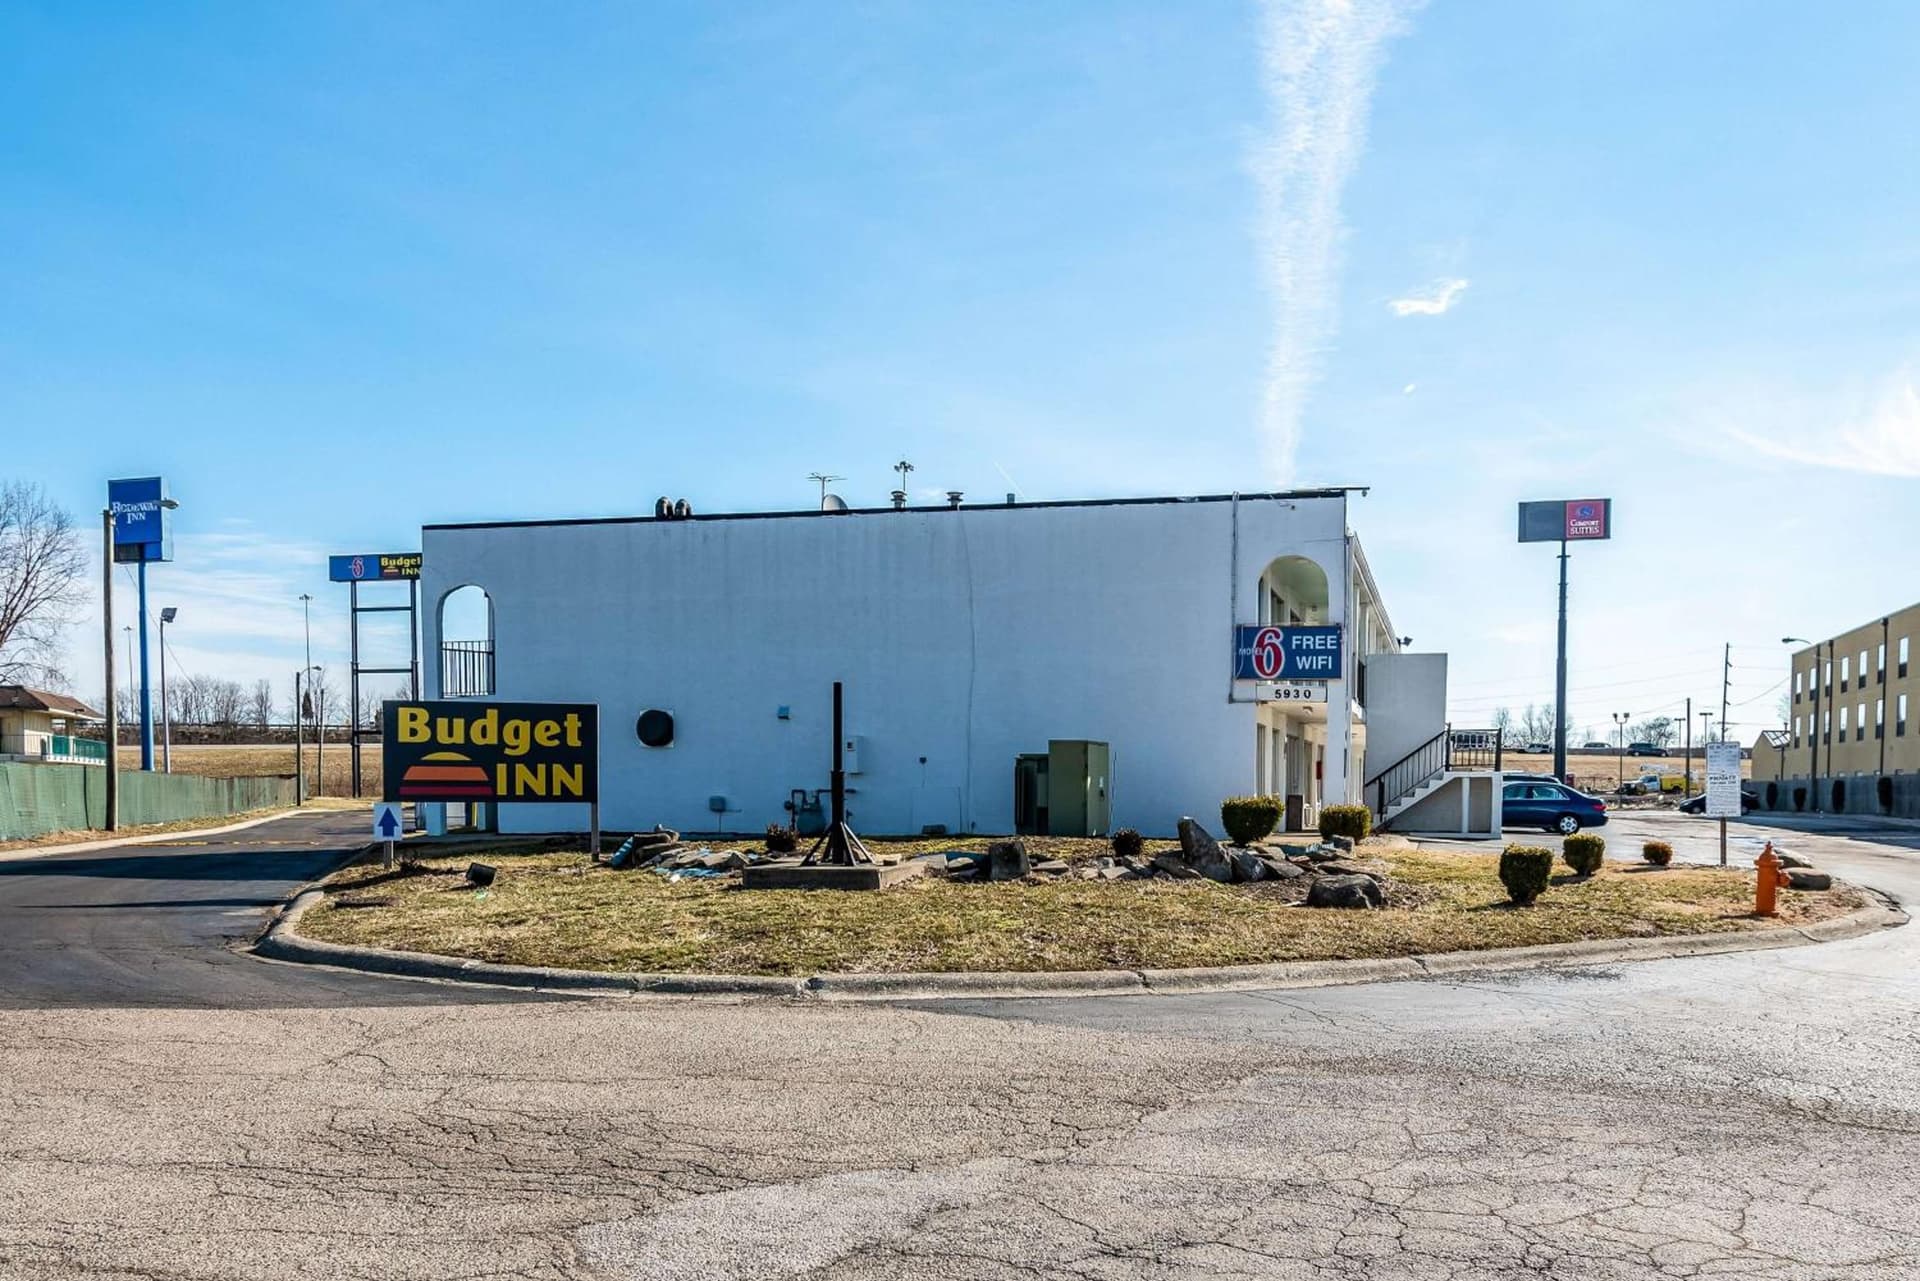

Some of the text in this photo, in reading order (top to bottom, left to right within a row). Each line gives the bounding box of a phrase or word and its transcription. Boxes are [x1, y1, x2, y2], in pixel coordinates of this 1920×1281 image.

[127, 512, 146, 524] INN
[1570, 526, 1599, 535] SUITES
[381, 556, 421, 567] Budget
[402, 567, 421, 576] INN
[1291, 635, 1338, 650] FREE
[1252, 627, 1285, 679] 6
[1296, 655, 1332, 670] WIFI
[1274, 689, 1312, 699] 5930
[397, 706, 582, 756] Budget
[496, 763, 584, 797] INN
